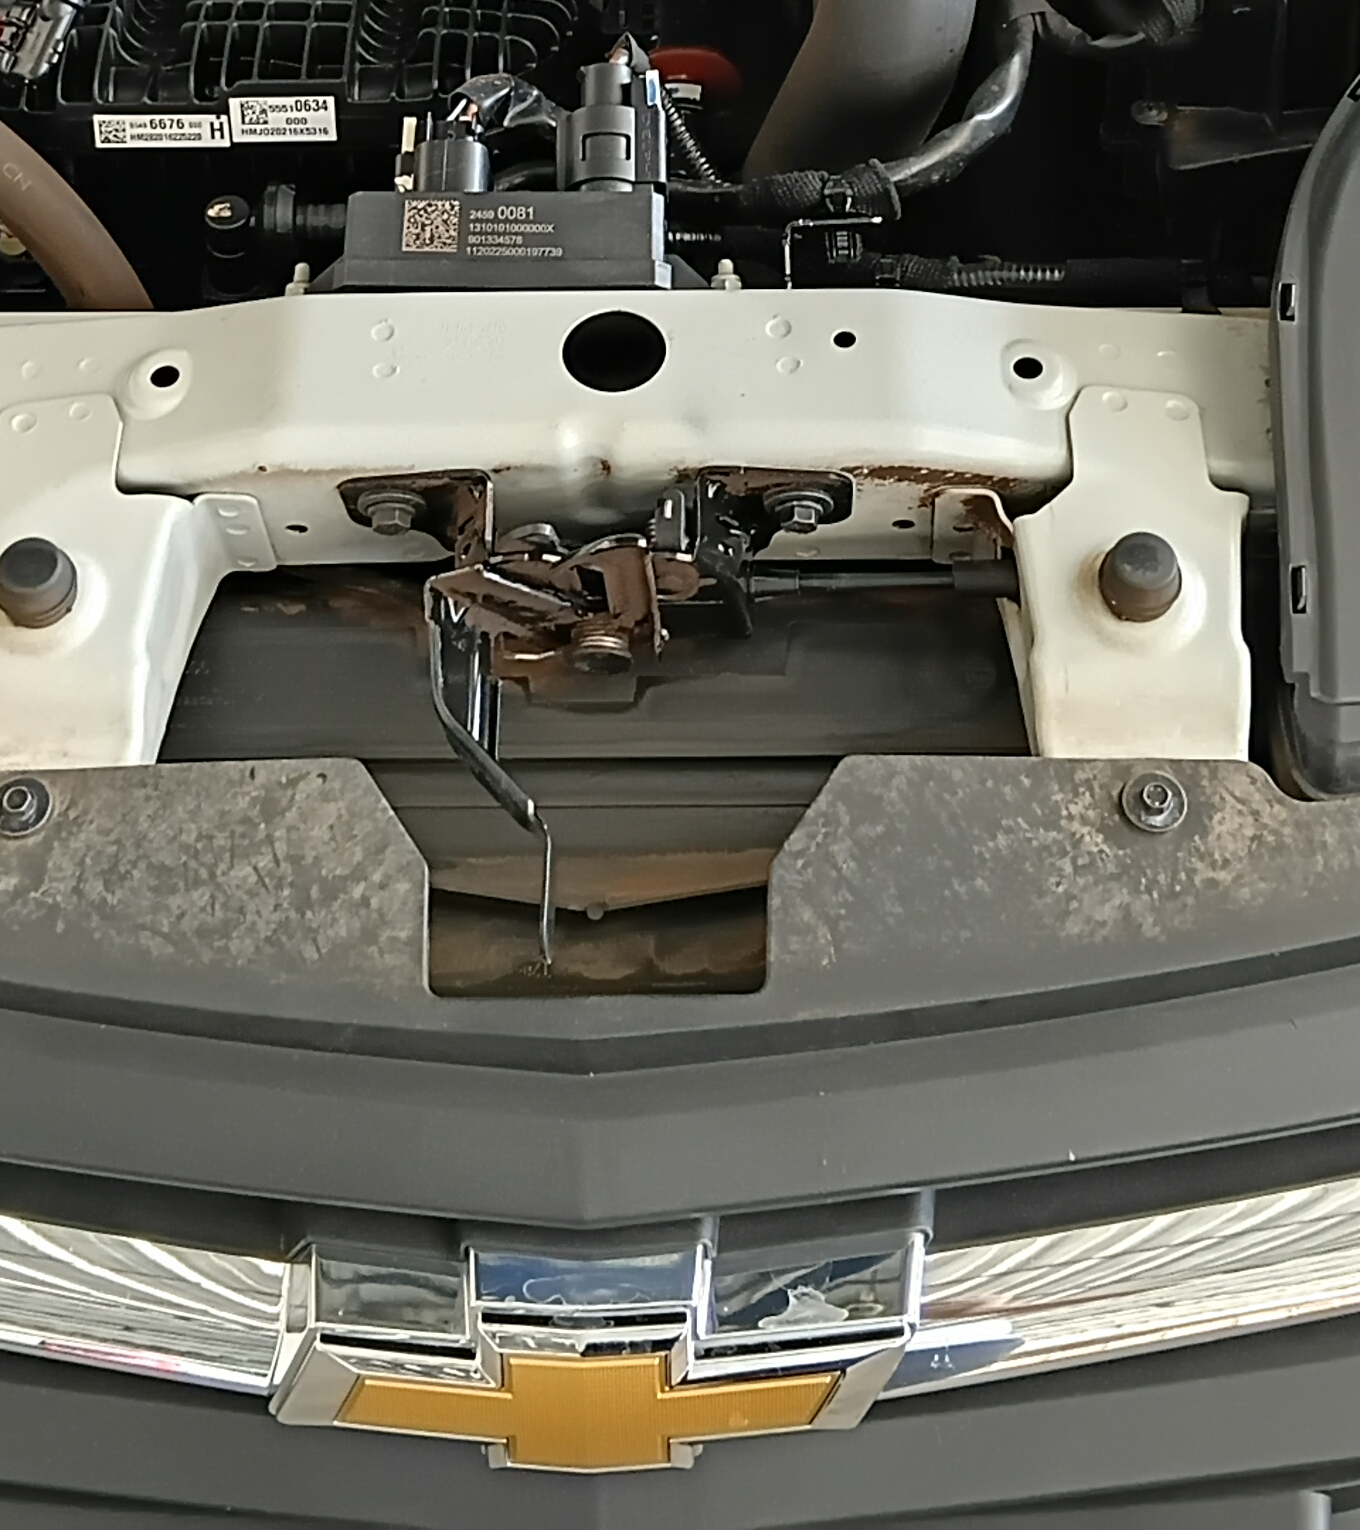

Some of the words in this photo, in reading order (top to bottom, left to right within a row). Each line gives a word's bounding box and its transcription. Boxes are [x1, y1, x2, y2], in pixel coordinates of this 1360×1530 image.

[149, 119, 185, 130] 6676
[210, 121, 224, 140] H
[2, 162, 33, 192] CN
[497, 206, 534, 220] 0081
